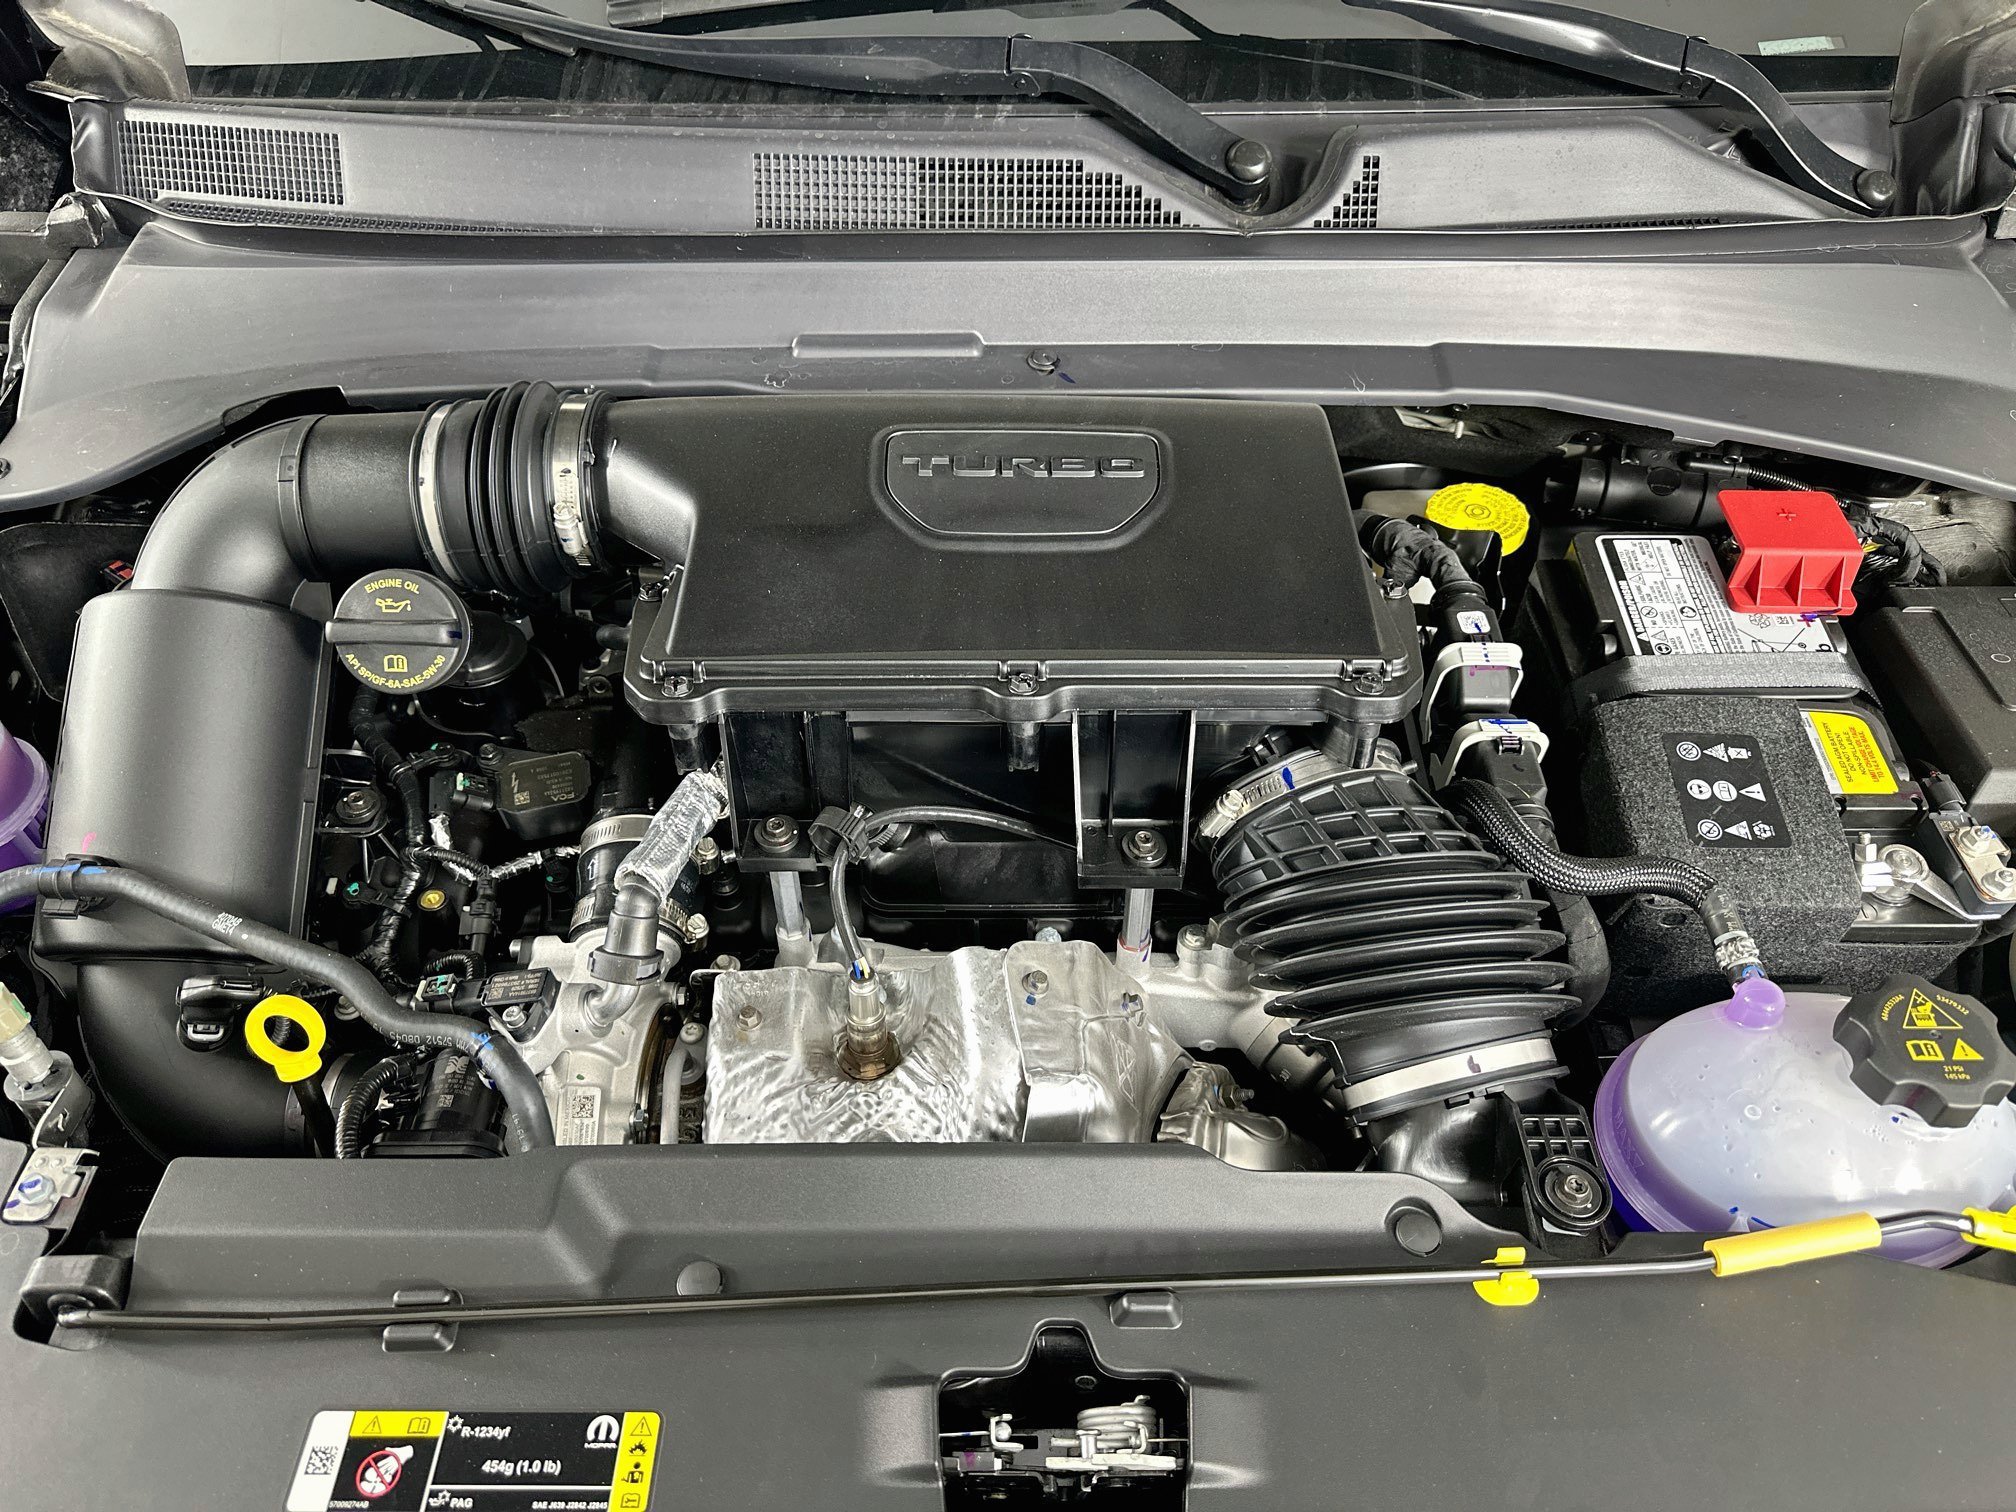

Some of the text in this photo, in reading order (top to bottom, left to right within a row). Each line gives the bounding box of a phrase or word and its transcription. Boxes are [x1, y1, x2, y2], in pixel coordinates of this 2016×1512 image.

[902, 456, 1144, 477] TURBO
[364, 578, 420, 594] ENGINE OIL
[345, 653, 361, 670] API
[1821, 722, 1837, 745] BATTERY
[1832, 747, 1842, 759] AGM
[1842, 731, 1867, 774] NON-SPILLABLE
[1838, 761, 1853, 782] SEALED
[551, 792, 575, 802] FCA
[460, 1426, 511, 1439] R-1234yf
[481, 1459, 562, 1476] 454g (1.0 lb)
[450, 1497, 473, 1508] PAG
[532, 1501, 548, 1509] SAE
